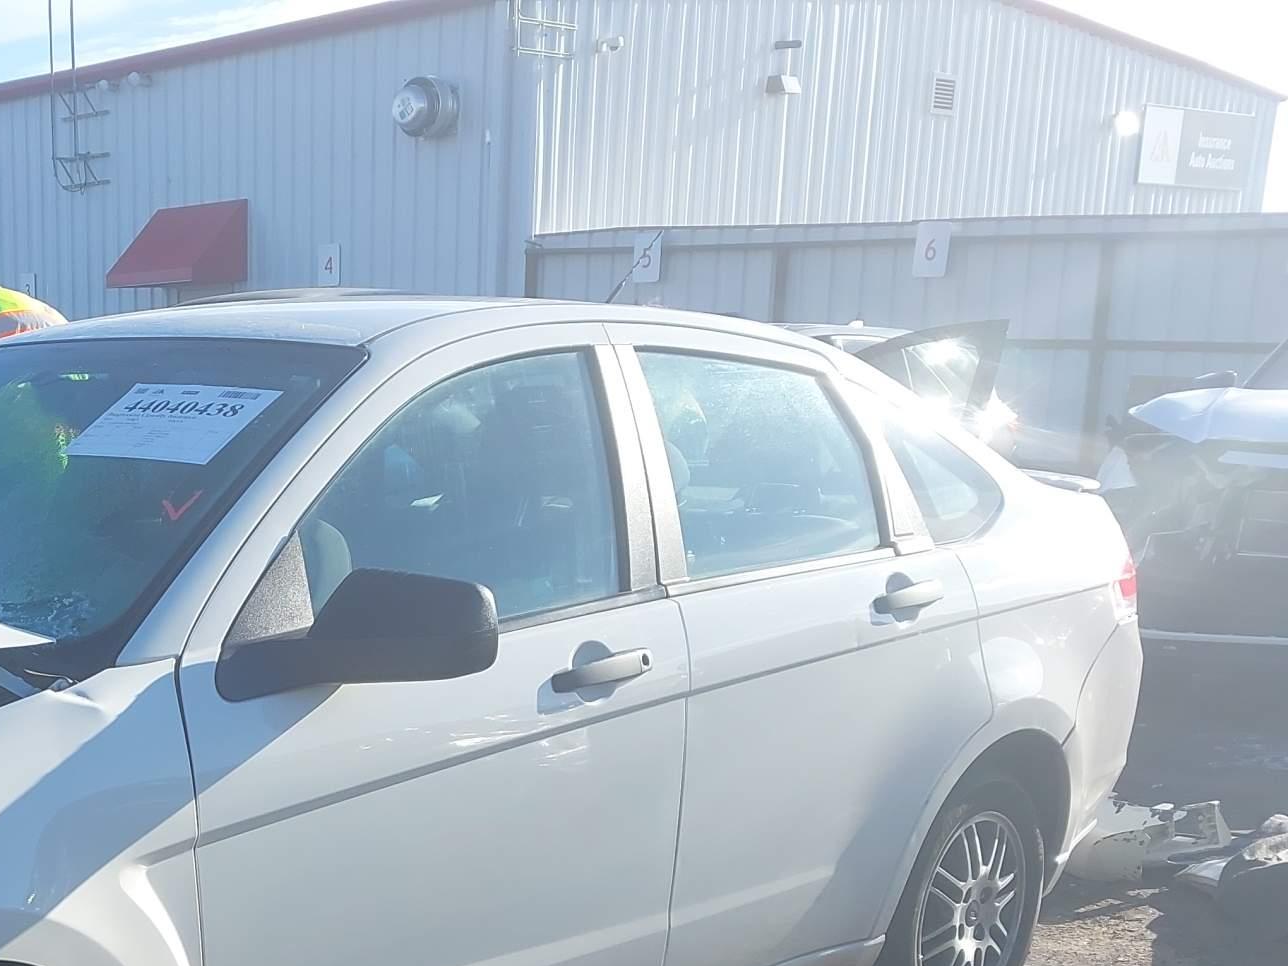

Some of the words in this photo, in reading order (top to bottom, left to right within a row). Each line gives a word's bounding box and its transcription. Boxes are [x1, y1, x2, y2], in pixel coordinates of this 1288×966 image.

[641, 247, 652, 268] 5
[925, 238, 936, 261] 6
[324, 256, 333, 274] 4
[123, 399, 245, 418] 44040438
